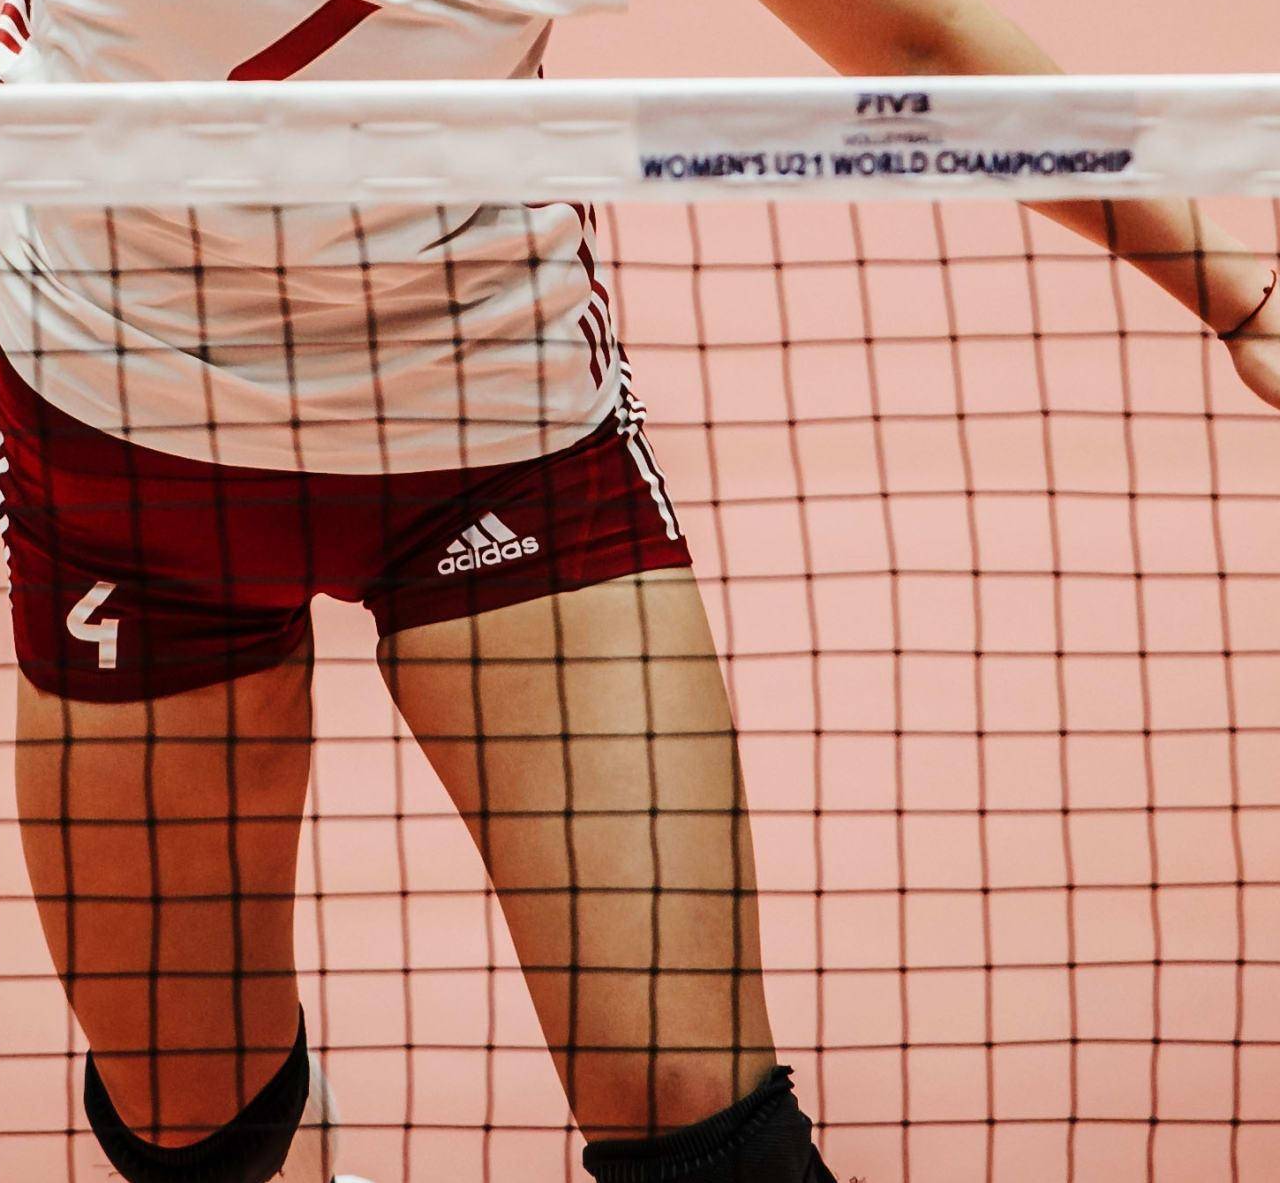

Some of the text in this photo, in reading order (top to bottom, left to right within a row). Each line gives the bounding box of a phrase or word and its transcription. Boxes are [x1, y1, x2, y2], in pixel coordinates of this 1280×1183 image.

[640, 149, 1132, 178] WOMEN'S U21 WORLD CHAMPIONSHIP
[438, 536, 540, 575] adidas
[66, 581, 119, 669] 4
